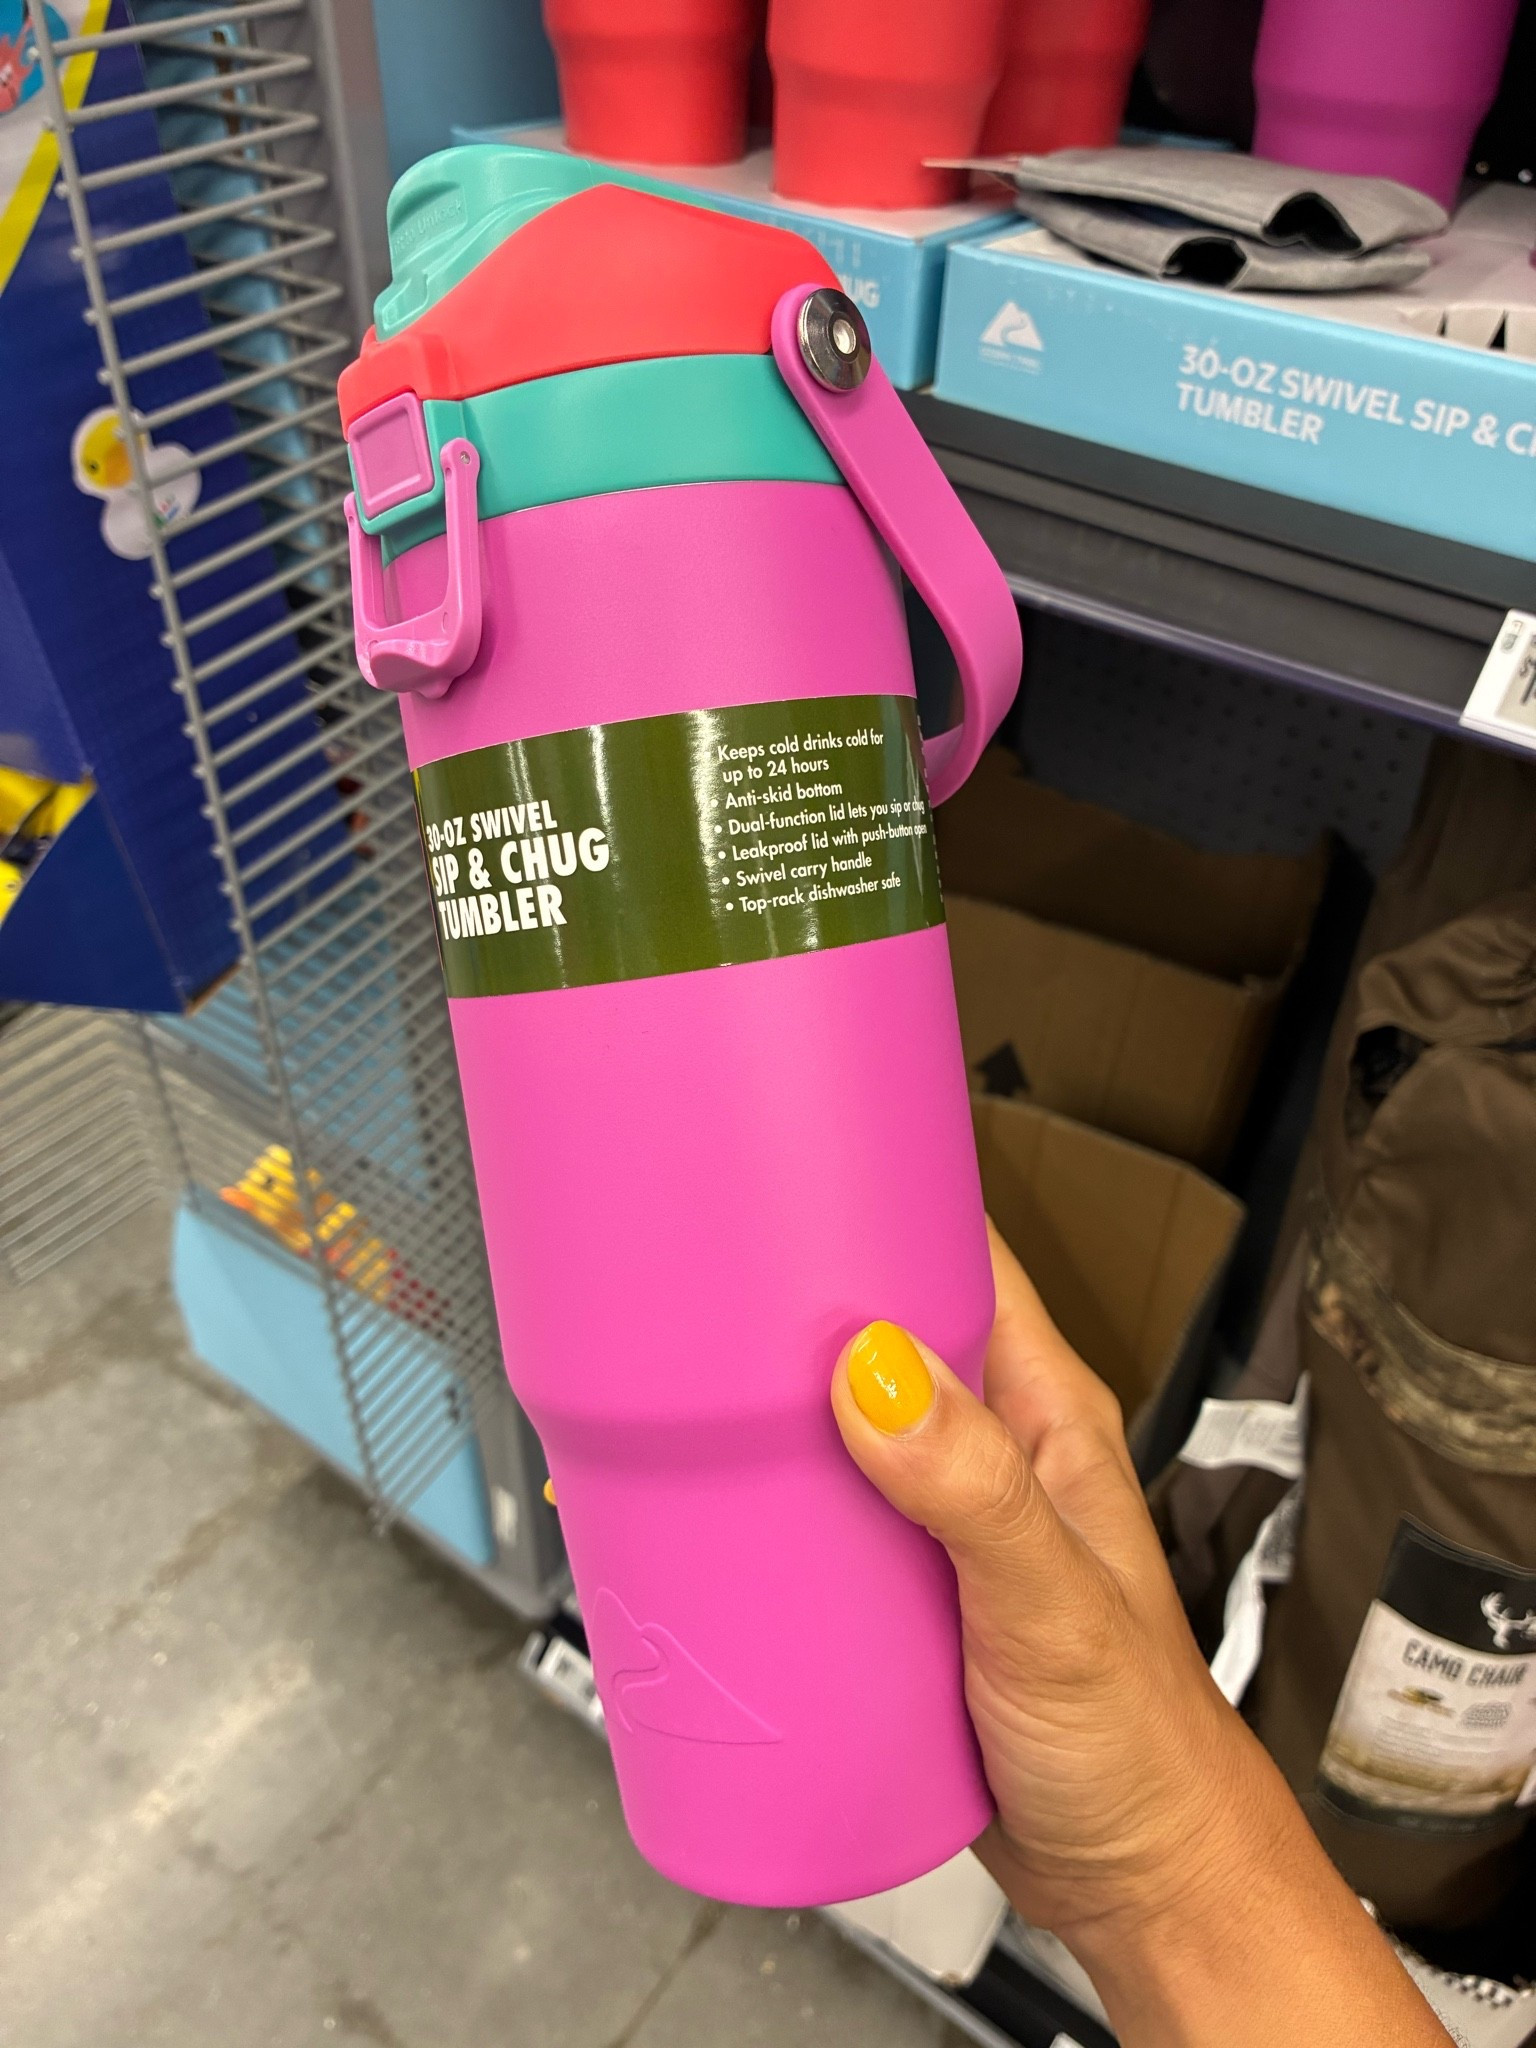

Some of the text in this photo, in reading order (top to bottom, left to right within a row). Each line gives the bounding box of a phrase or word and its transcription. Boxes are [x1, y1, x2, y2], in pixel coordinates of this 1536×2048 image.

[1176, 381, 1325, 445] TUMBLER
[1178, 344, 1278, 394] 30-OZ
[1278, 368, 1405, 426] SWIVEL
[1410, 398, 1471, 438] SIP
[1471, 412, 1501, 448] &
[718, 728, 884, 762] Keeps cold drinks cold for
[722, 756, 830, 786] up to 24 hours
[725, 782, 843, 809] Anti-skid bottom
[728, 795, 925, 835] Dual-function lid lets you sip or chug
[426, 800, 558, 852] 30-OZ SWIVEL
[732, 822, 928, 861] Leakproof lid with push-button open
[432, 827, 610, 896] SIP & CHUG
[736, 851, 872, 886] Swivel carry handle
[438, 884, 568, 940] TUMBLER
[739, 871, 901, 915] Top-rack dishwasher safe
[1402, 1637, 1467, 1684] CAMO
